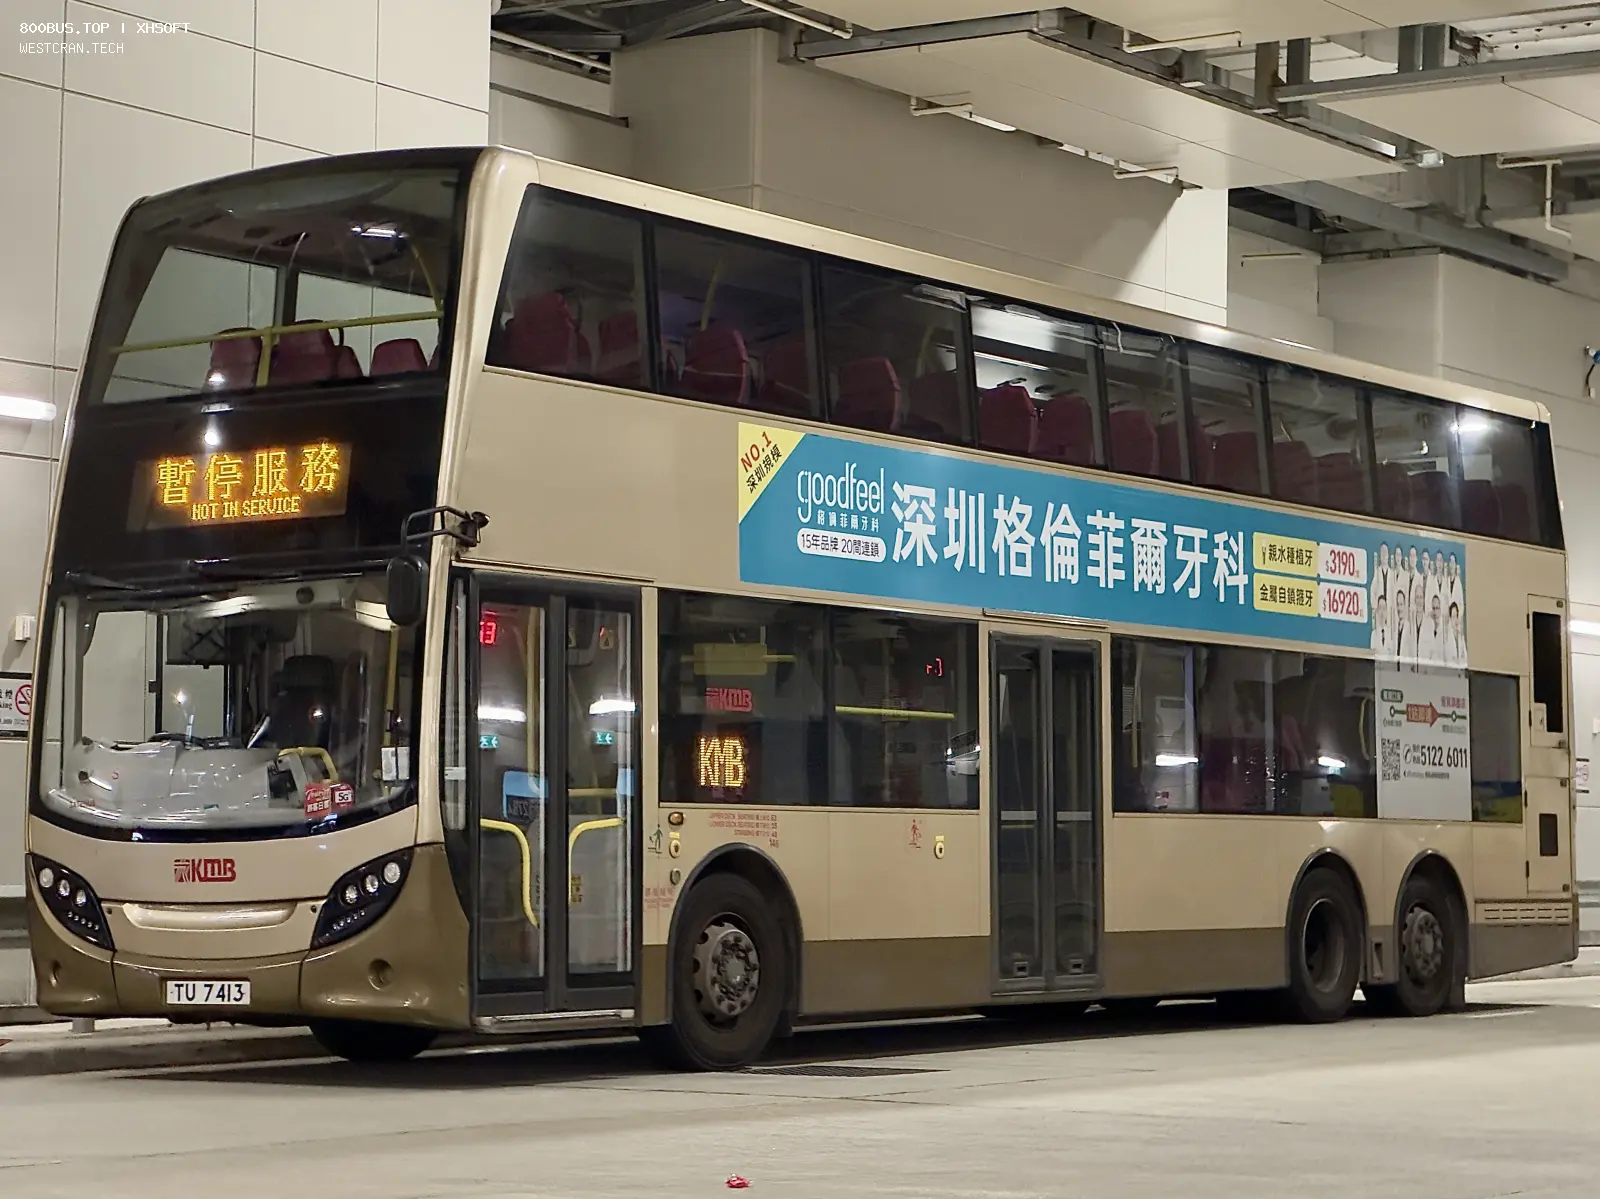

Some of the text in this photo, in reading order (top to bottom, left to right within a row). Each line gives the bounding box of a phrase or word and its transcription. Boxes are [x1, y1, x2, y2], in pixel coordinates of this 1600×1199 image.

[740, 431, 772, 473] NO.1
[157, 443, 340, 504] 暫停服務
[746, 444, 782, 494] 深圳規模
[797, 461, 885, 523] goodfeel
[191, 497, 301, 521] NOT IN SERVICE
[817, 509, 879, 532] 格倫菲爾牙科
[891, 481, 1249, 605] 深圳格倫菲爾牙科
[1268, 544, 1313, 567] 親水種植牙
[1260, 583, 1313, 608] 金屬自鎖箍牙
[719, 688, 753, 712] KMB
[700, 737, 744, 787] KMB
[1420, 745, 1468, 769] 5122 6011
[338, 792, 349, 802] 5G
[192, 858, 237, 882] KMB
[174, 983, 244, 1002] TU 7413
